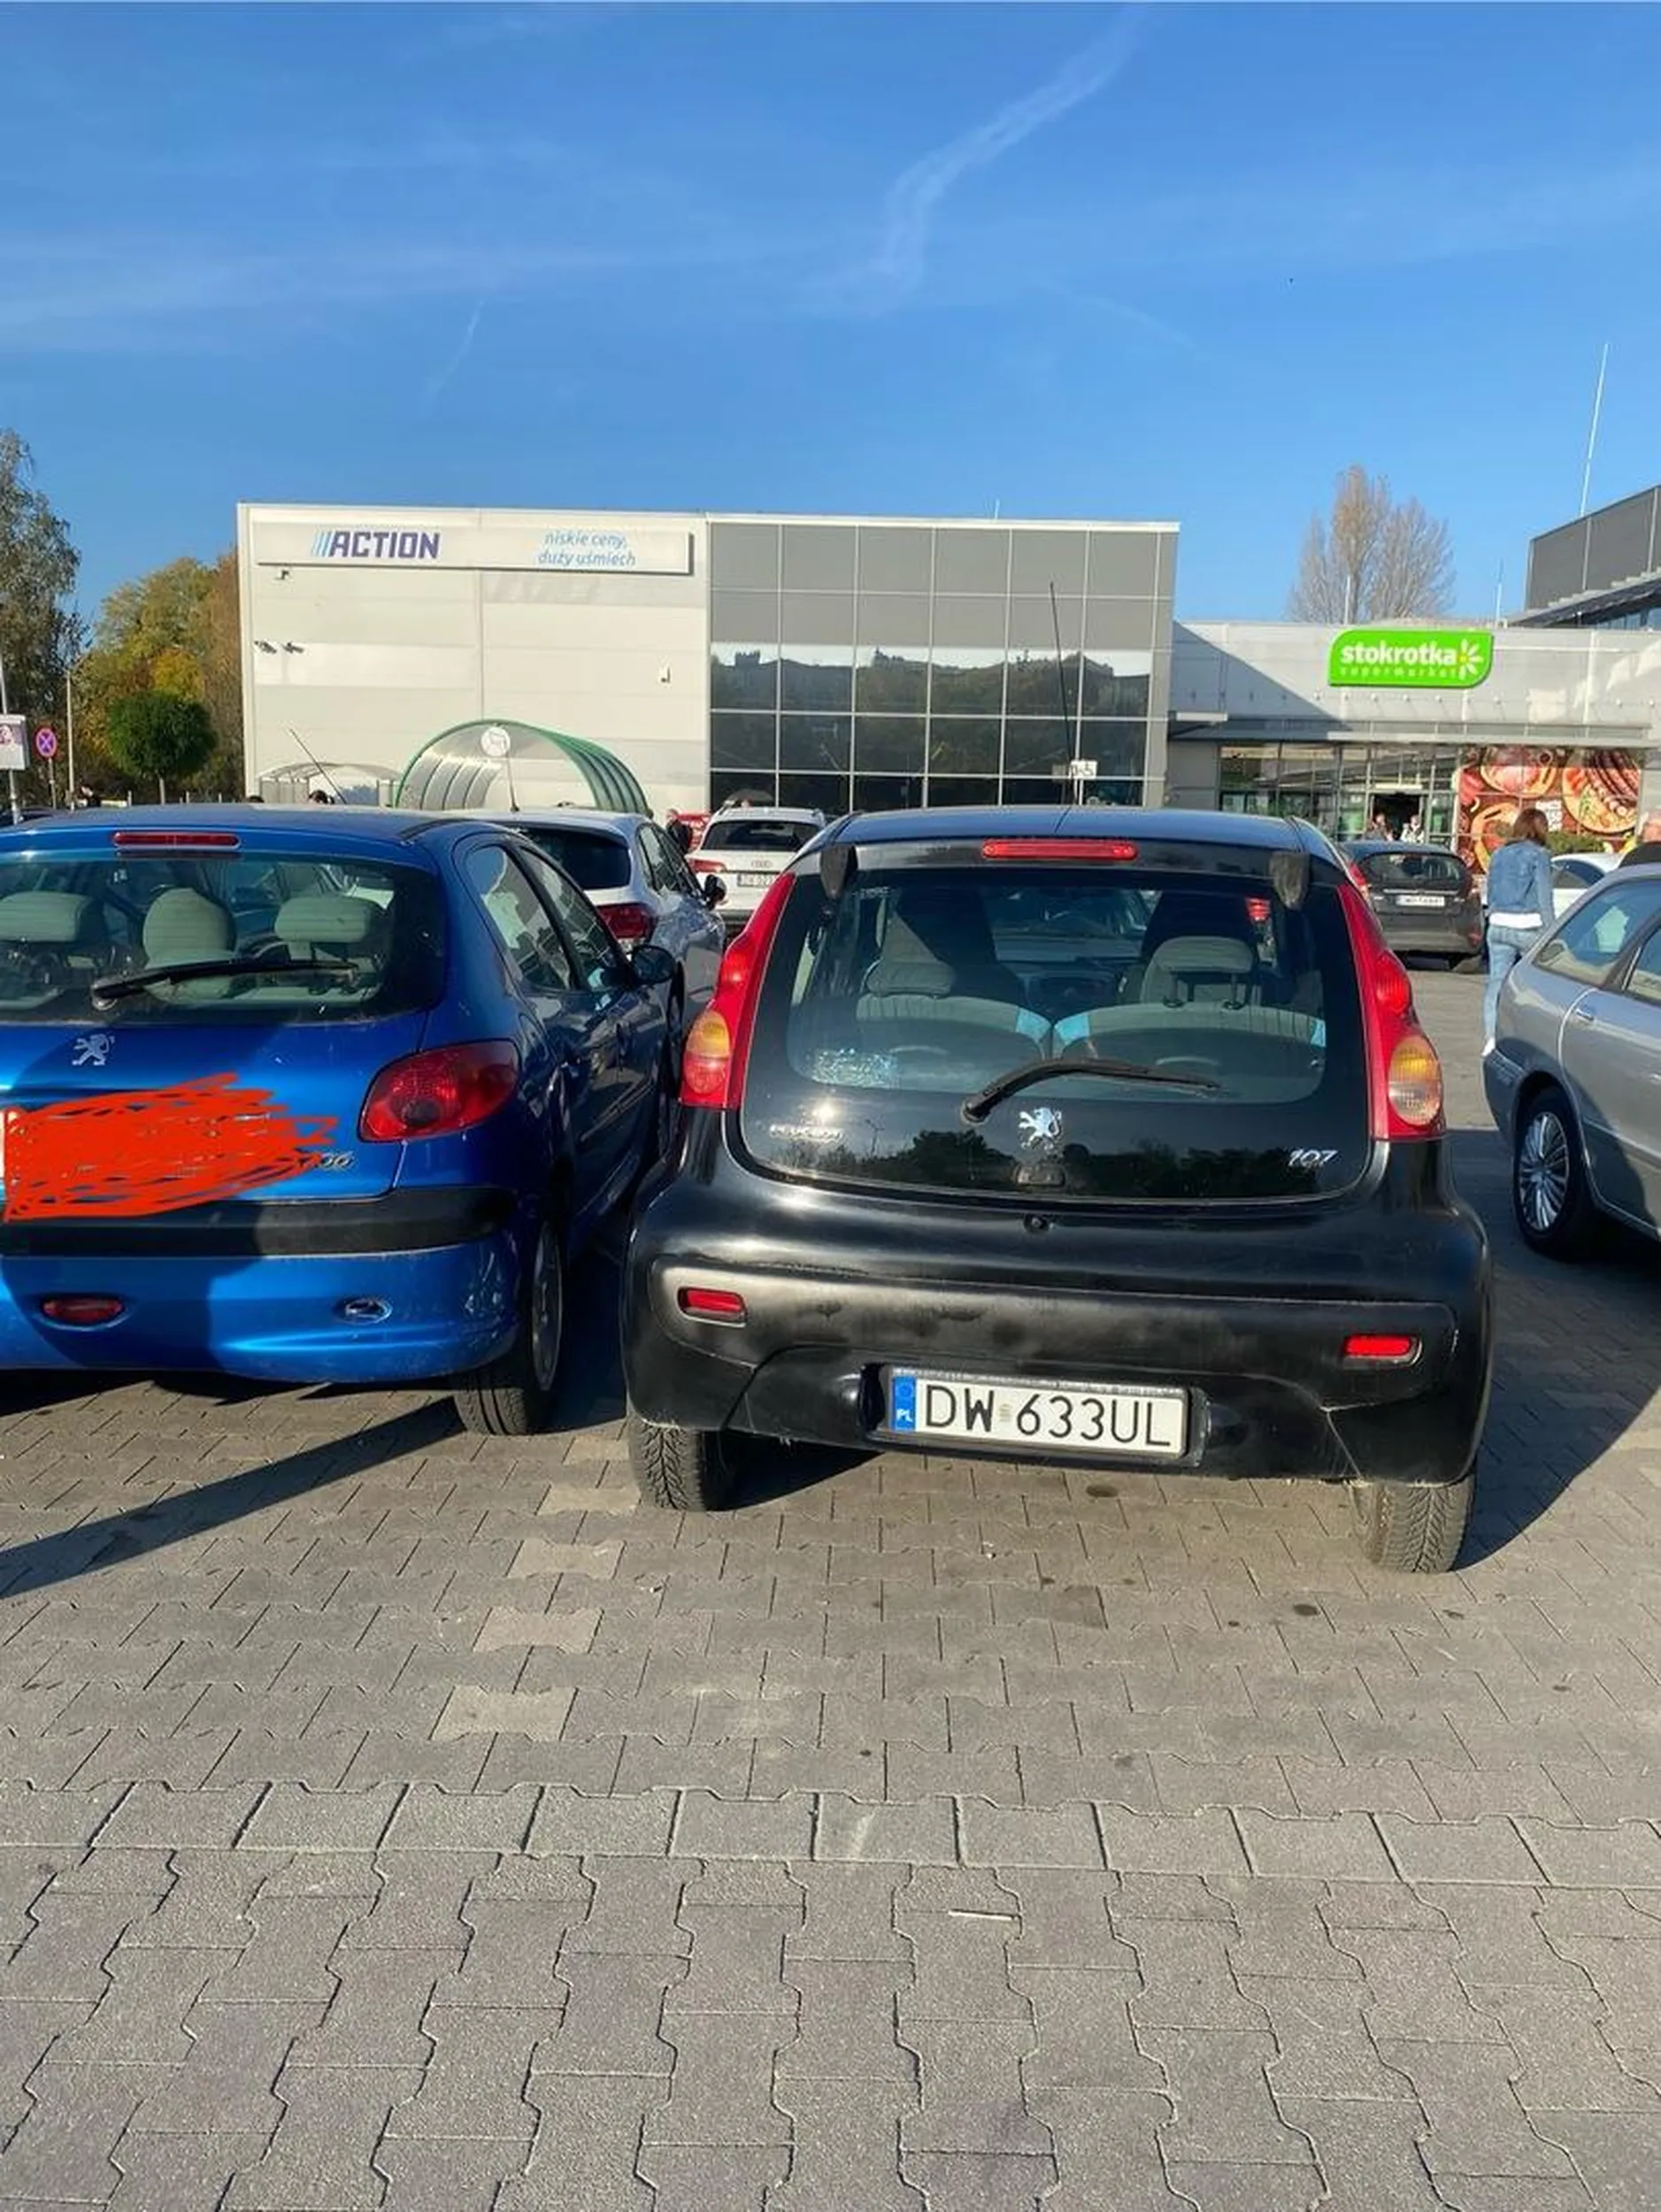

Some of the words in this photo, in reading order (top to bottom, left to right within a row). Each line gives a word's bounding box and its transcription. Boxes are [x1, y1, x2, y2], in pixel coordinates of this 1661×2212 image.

[328, 531, 440, 558] ACTION
[544, 531, 588, 546] niskie
[1341, 639, 1457, 666] stokrotka
[317, 1151, 355, 1168] 06
[1288, 1149, 1338, 1167] 107
[896, 1409, 913, 1423] PL
[926, 1384, 995, 1433] DW
[1016, 1394, 1172, 1448] 633UL
